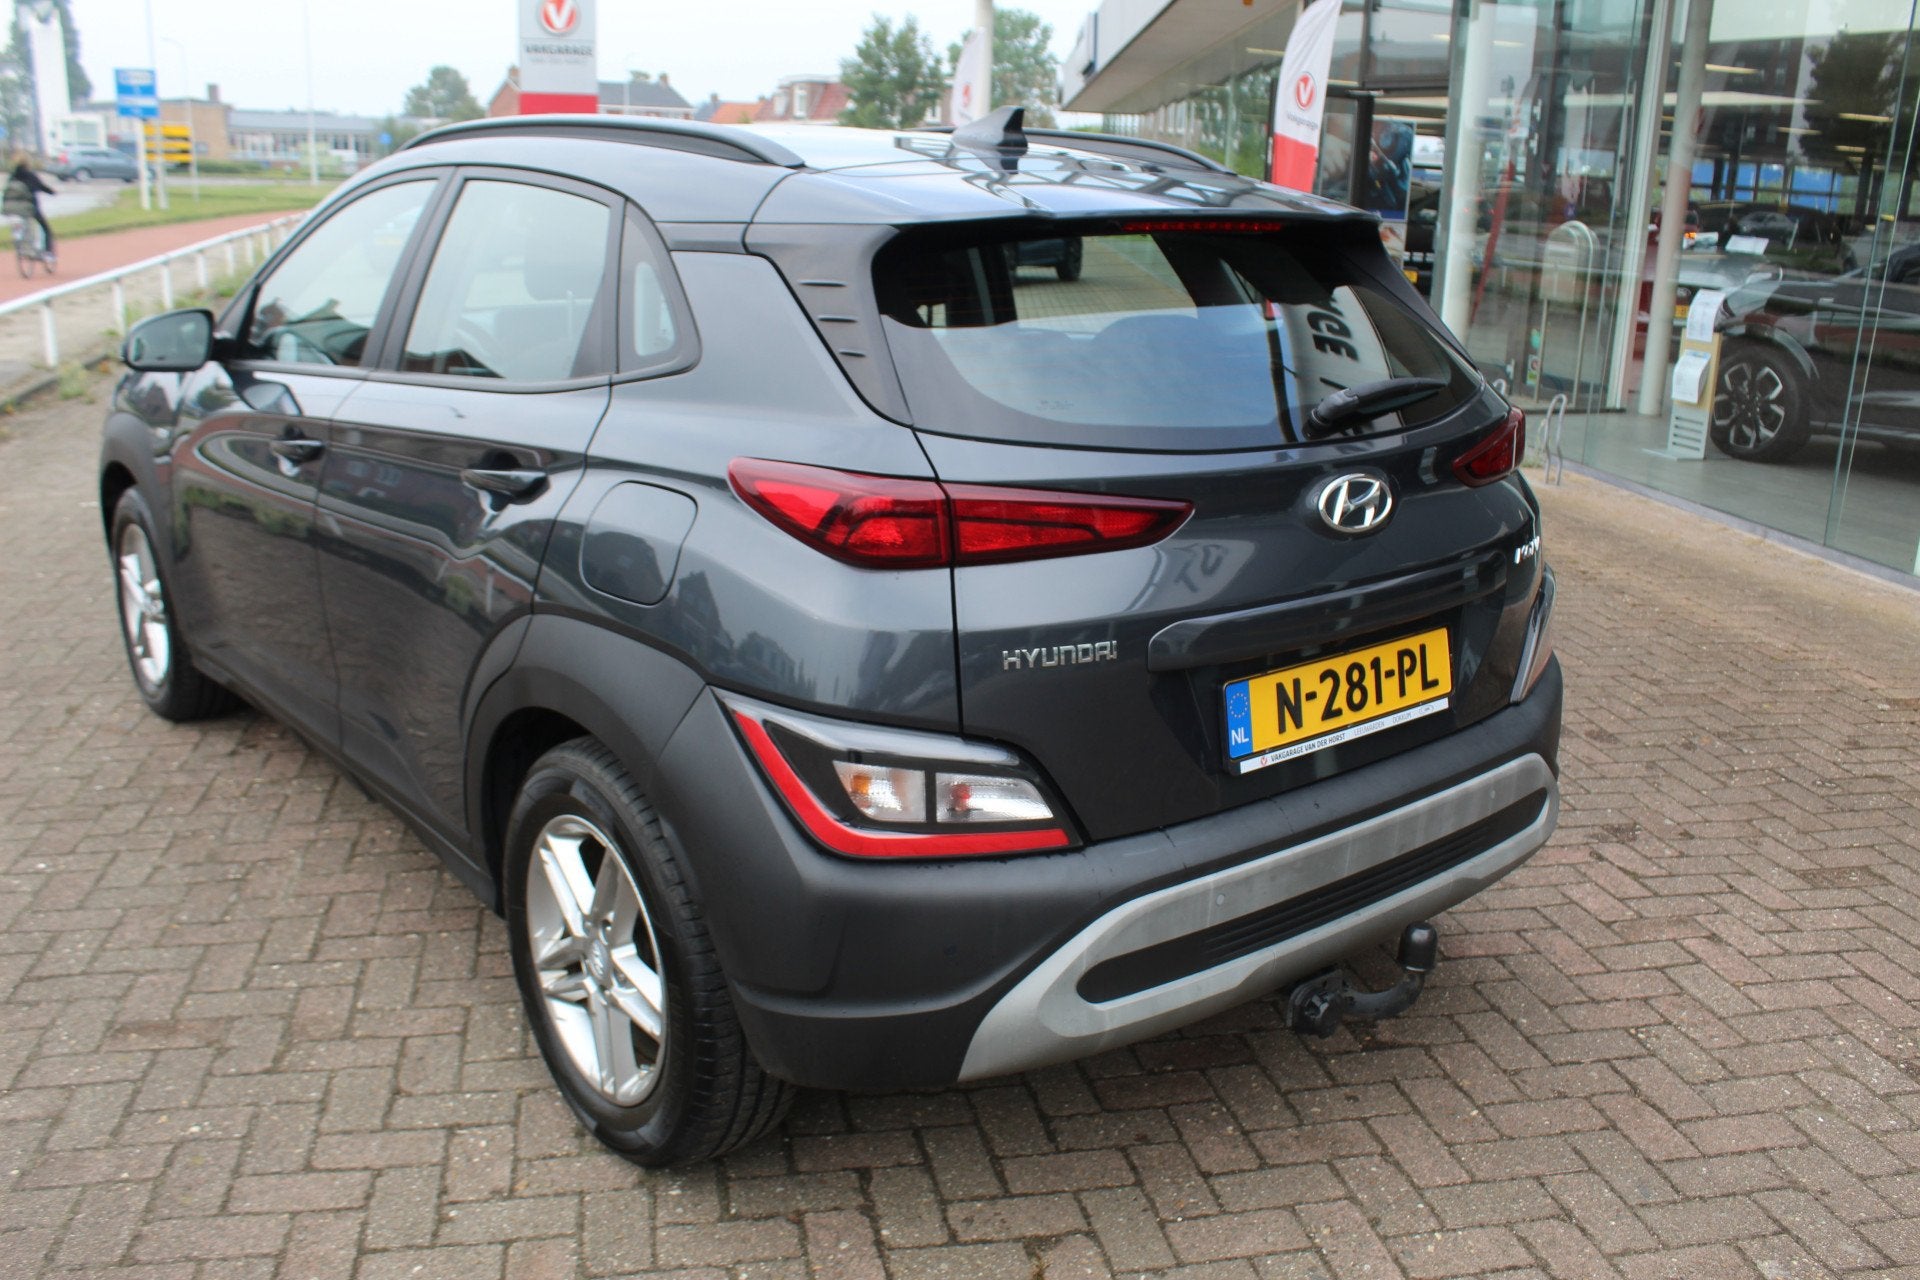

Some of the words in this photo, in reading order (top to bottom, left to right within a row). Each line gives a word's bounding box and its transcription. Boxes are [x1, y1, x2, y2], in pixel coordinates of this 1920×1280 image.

[1002, 640, 1118, 670] HYUNDAI
[1275, 643, 1440, 735] N-281-PL
[1231, 727, 1250, 746] NL
[1270, 745, 1304, 762] VAKGARAGE
[1304, 742, 1317, 752] VAN
[1317, 738, 1328, 748] DER
[1328, 732, 1346, 744] HORST
